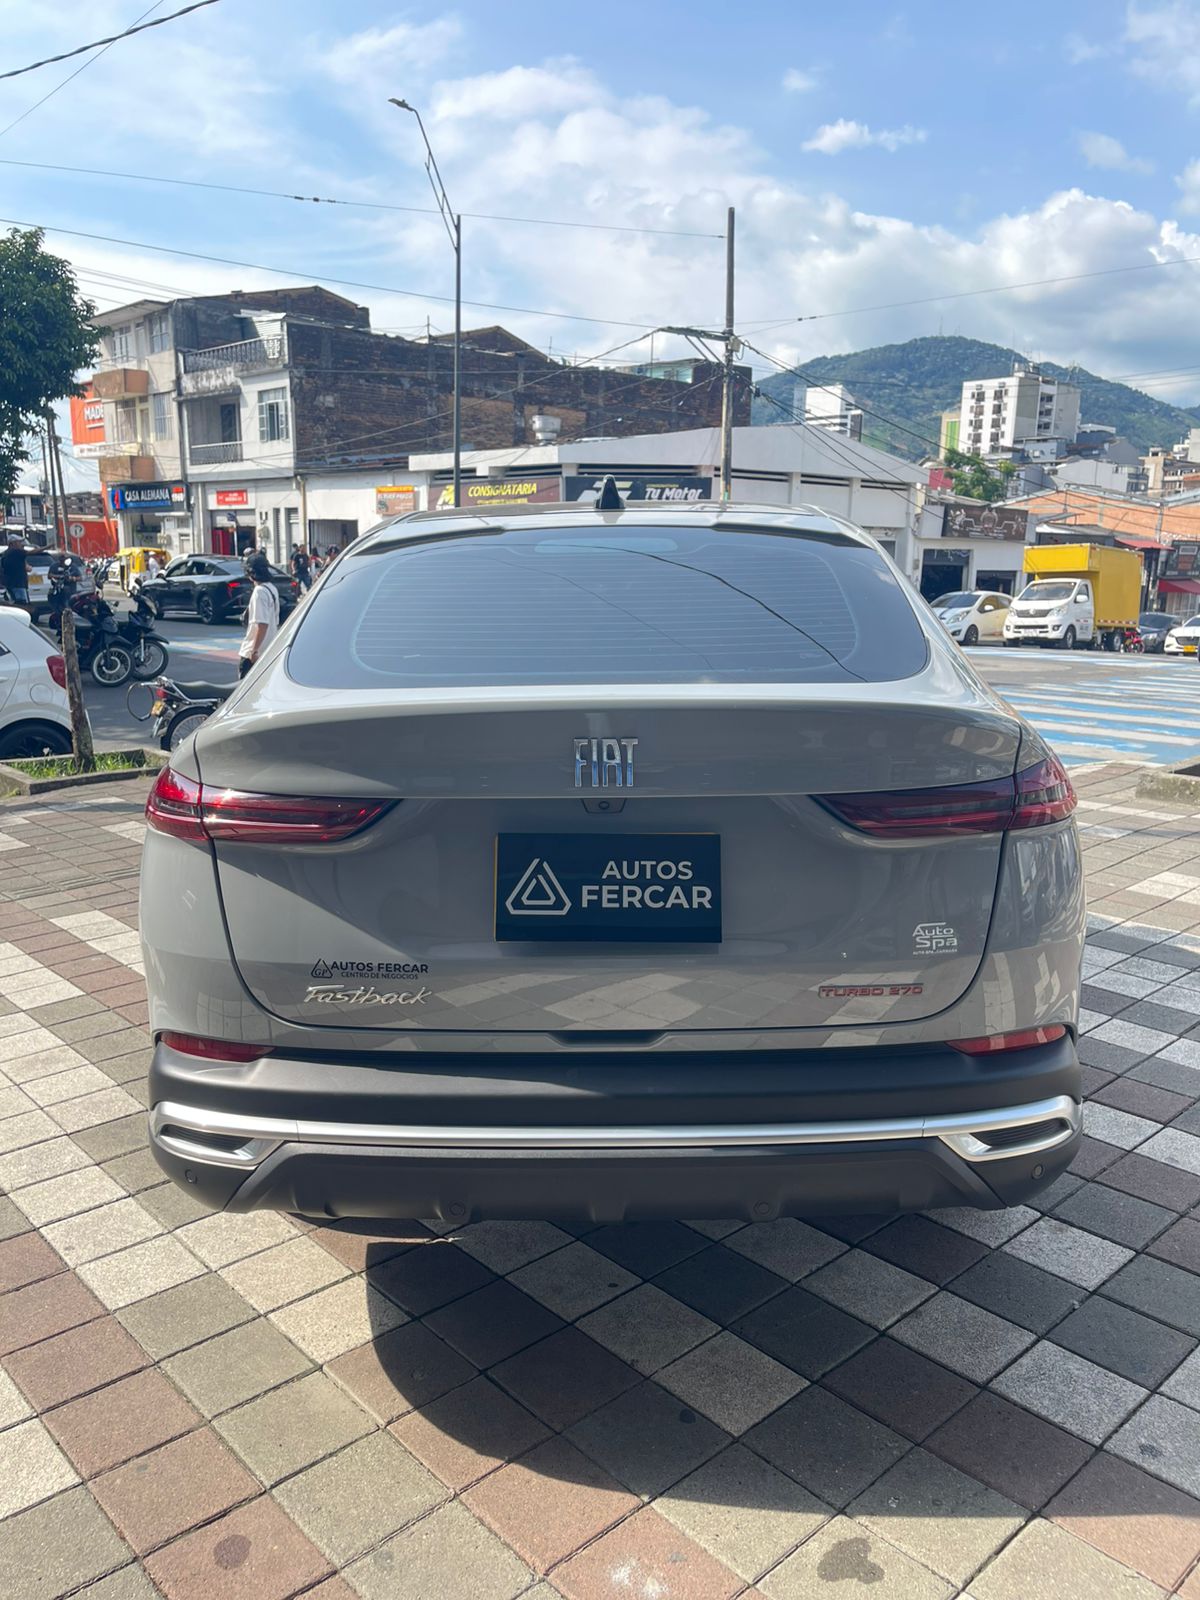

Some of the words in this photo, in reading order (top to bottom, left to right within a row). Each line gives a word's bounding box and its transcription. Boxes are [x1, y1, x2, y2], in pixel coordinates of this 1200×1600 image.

[125, 490, 139, 501] CASA
[140, 486, 170, 500] ALEMANA
[468, 483, 537, 497] CONSIGNATARIA
[662, 487, 703, 501] Motor
[574, 738, 638, 787] FIAT
[602, 860, 693, 880] AUTOS
[582, 885, 712, 909] FERCAR
[912, 922, 954, 937] Auto
[916, 936, 957, 950] Spa
[331, 961, 373, 972] AUTOS
[378, 963, 428, 973] FERCAR
[341, 971, 369, 979] CENTRO
[304, 985, 432, 1004] Fastback
[822, 986, 884, 997] TURBO
[889, 985, 923, 996] 270
